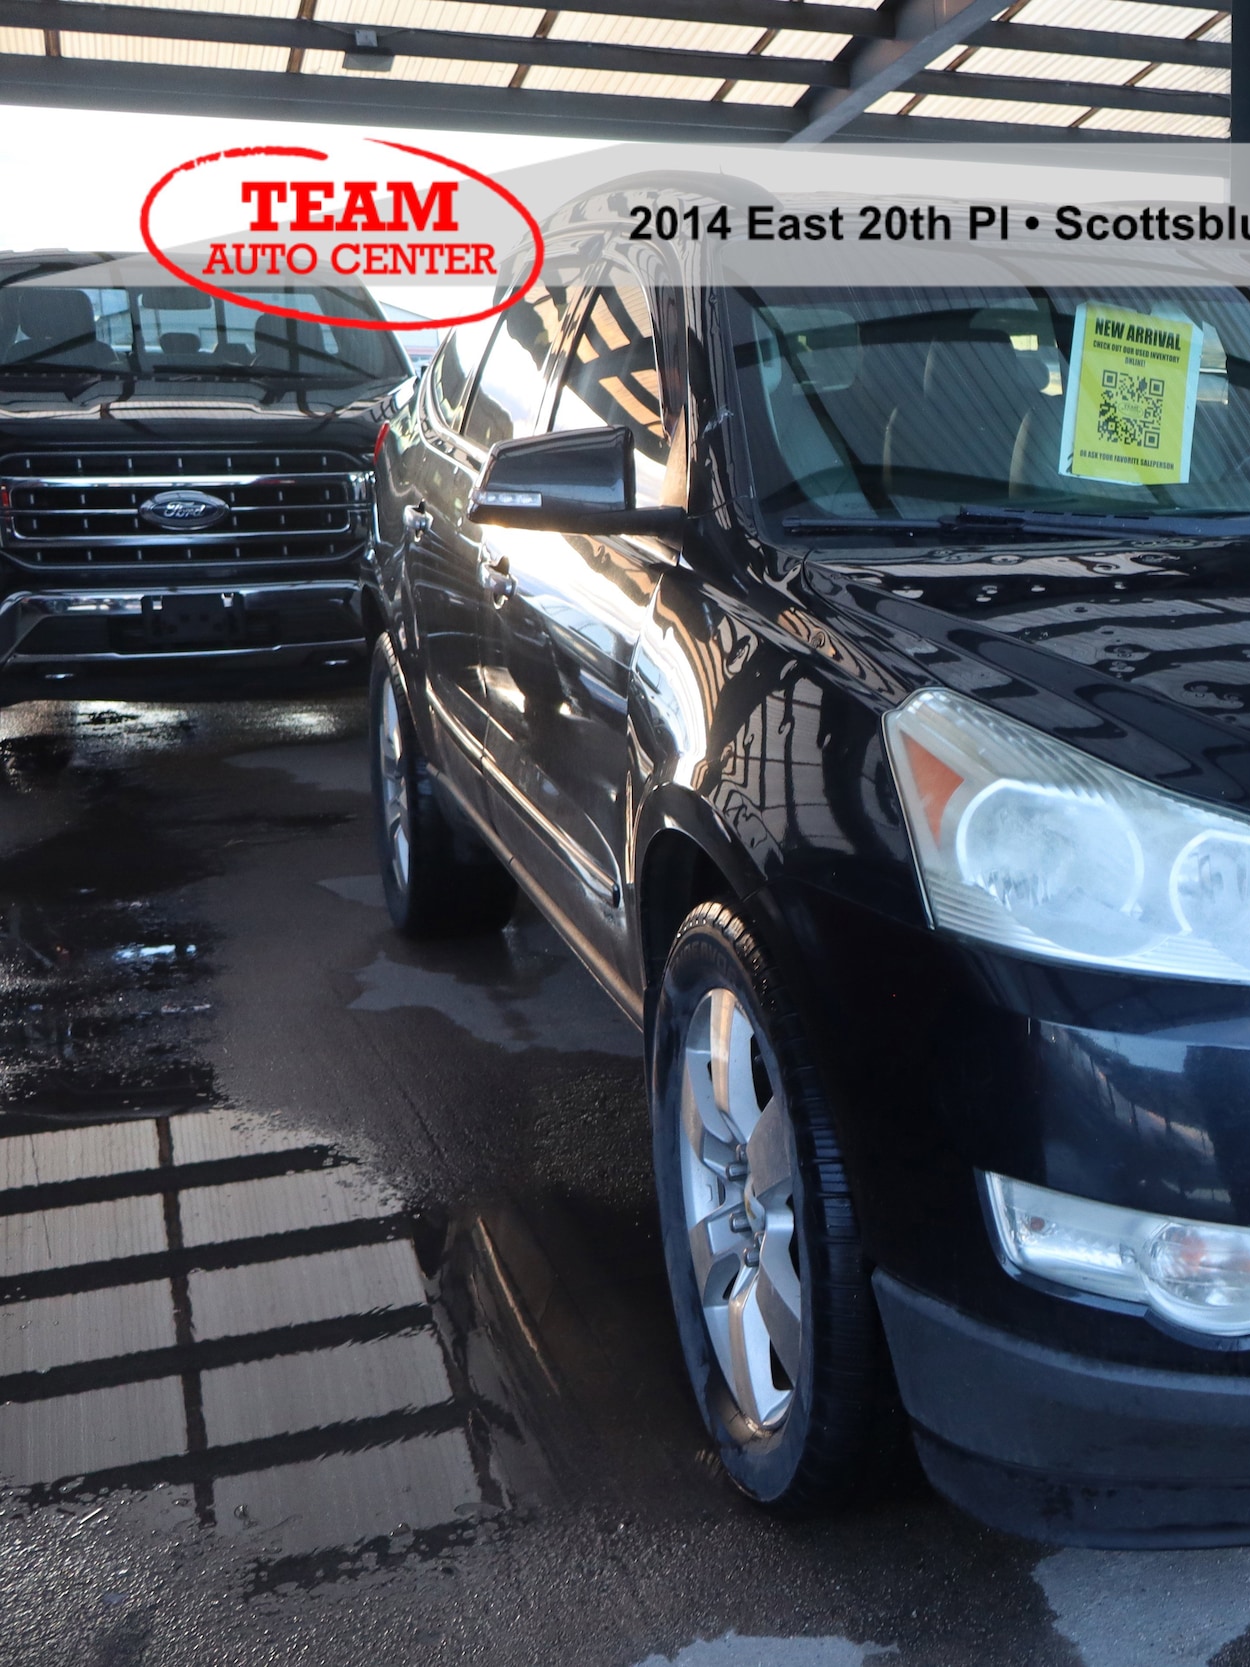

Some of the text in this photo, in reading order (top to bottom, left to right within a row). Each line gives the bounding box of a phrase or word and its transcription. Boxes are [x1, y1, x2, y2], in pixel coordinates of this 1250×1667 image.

[1095, 318, 1181, 351] NEW ARRIVAL
[1093, 340, 1180, 364] CHECK OUT OUR USED INVENTORY
[1125, 356, 1146, 368] ONLINE!
[1080, 449, 1087, 457] OR
[1087, 450, 1098, 459] ASK
[1099, 452, 1113, 462] YOUR
[1114, 454, 1139, 466] FAVORITE
[163, 501, 206, 518] Ford
